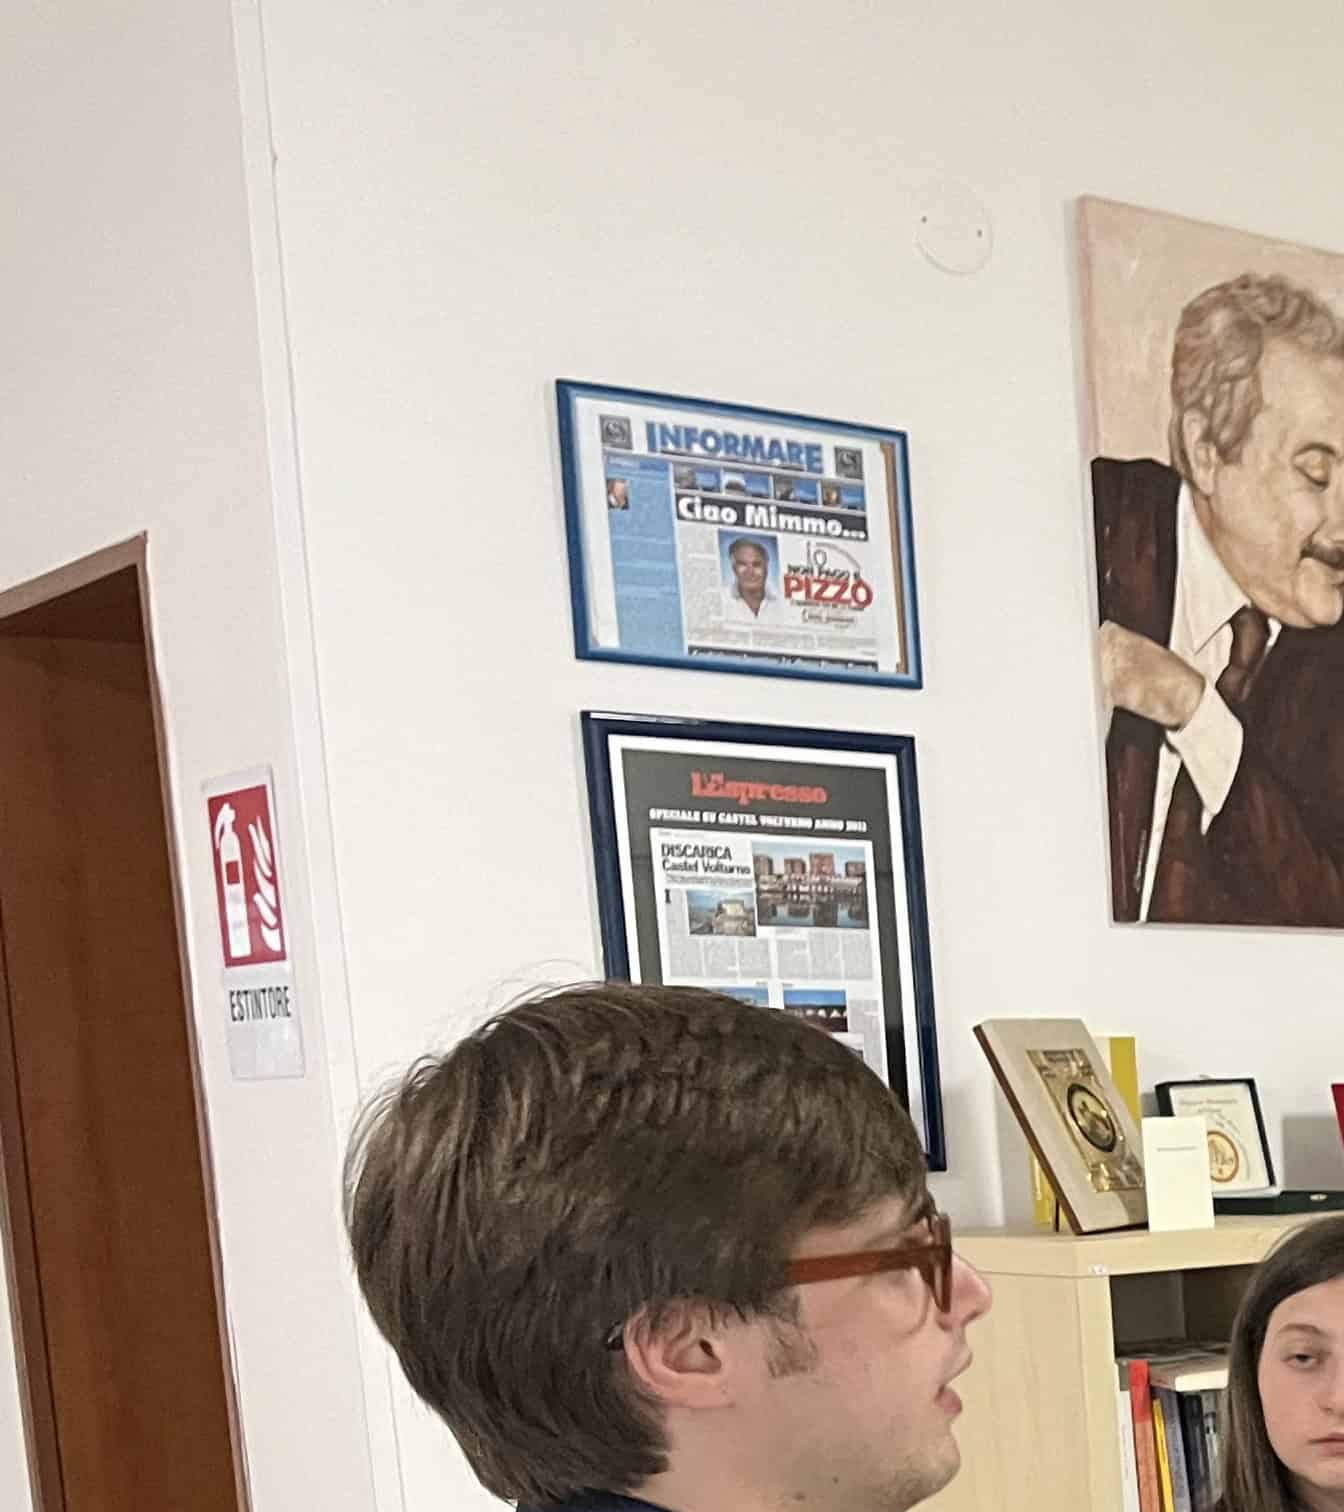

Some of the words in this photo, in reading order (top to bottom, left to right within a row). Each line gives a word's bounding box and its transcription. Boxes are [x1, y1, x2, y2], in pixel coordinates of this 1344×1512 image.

[646, 421, 824, 473] INFORMARE
[677, 497, 737, 525] Ciao
[745, 508, 867, 540] Mimmo...
[783, 575, 873, 609] PIZZO
[661, 844, 733, 861] DISCARICA
[229, 987, 291, 1021] ESTINTORE
